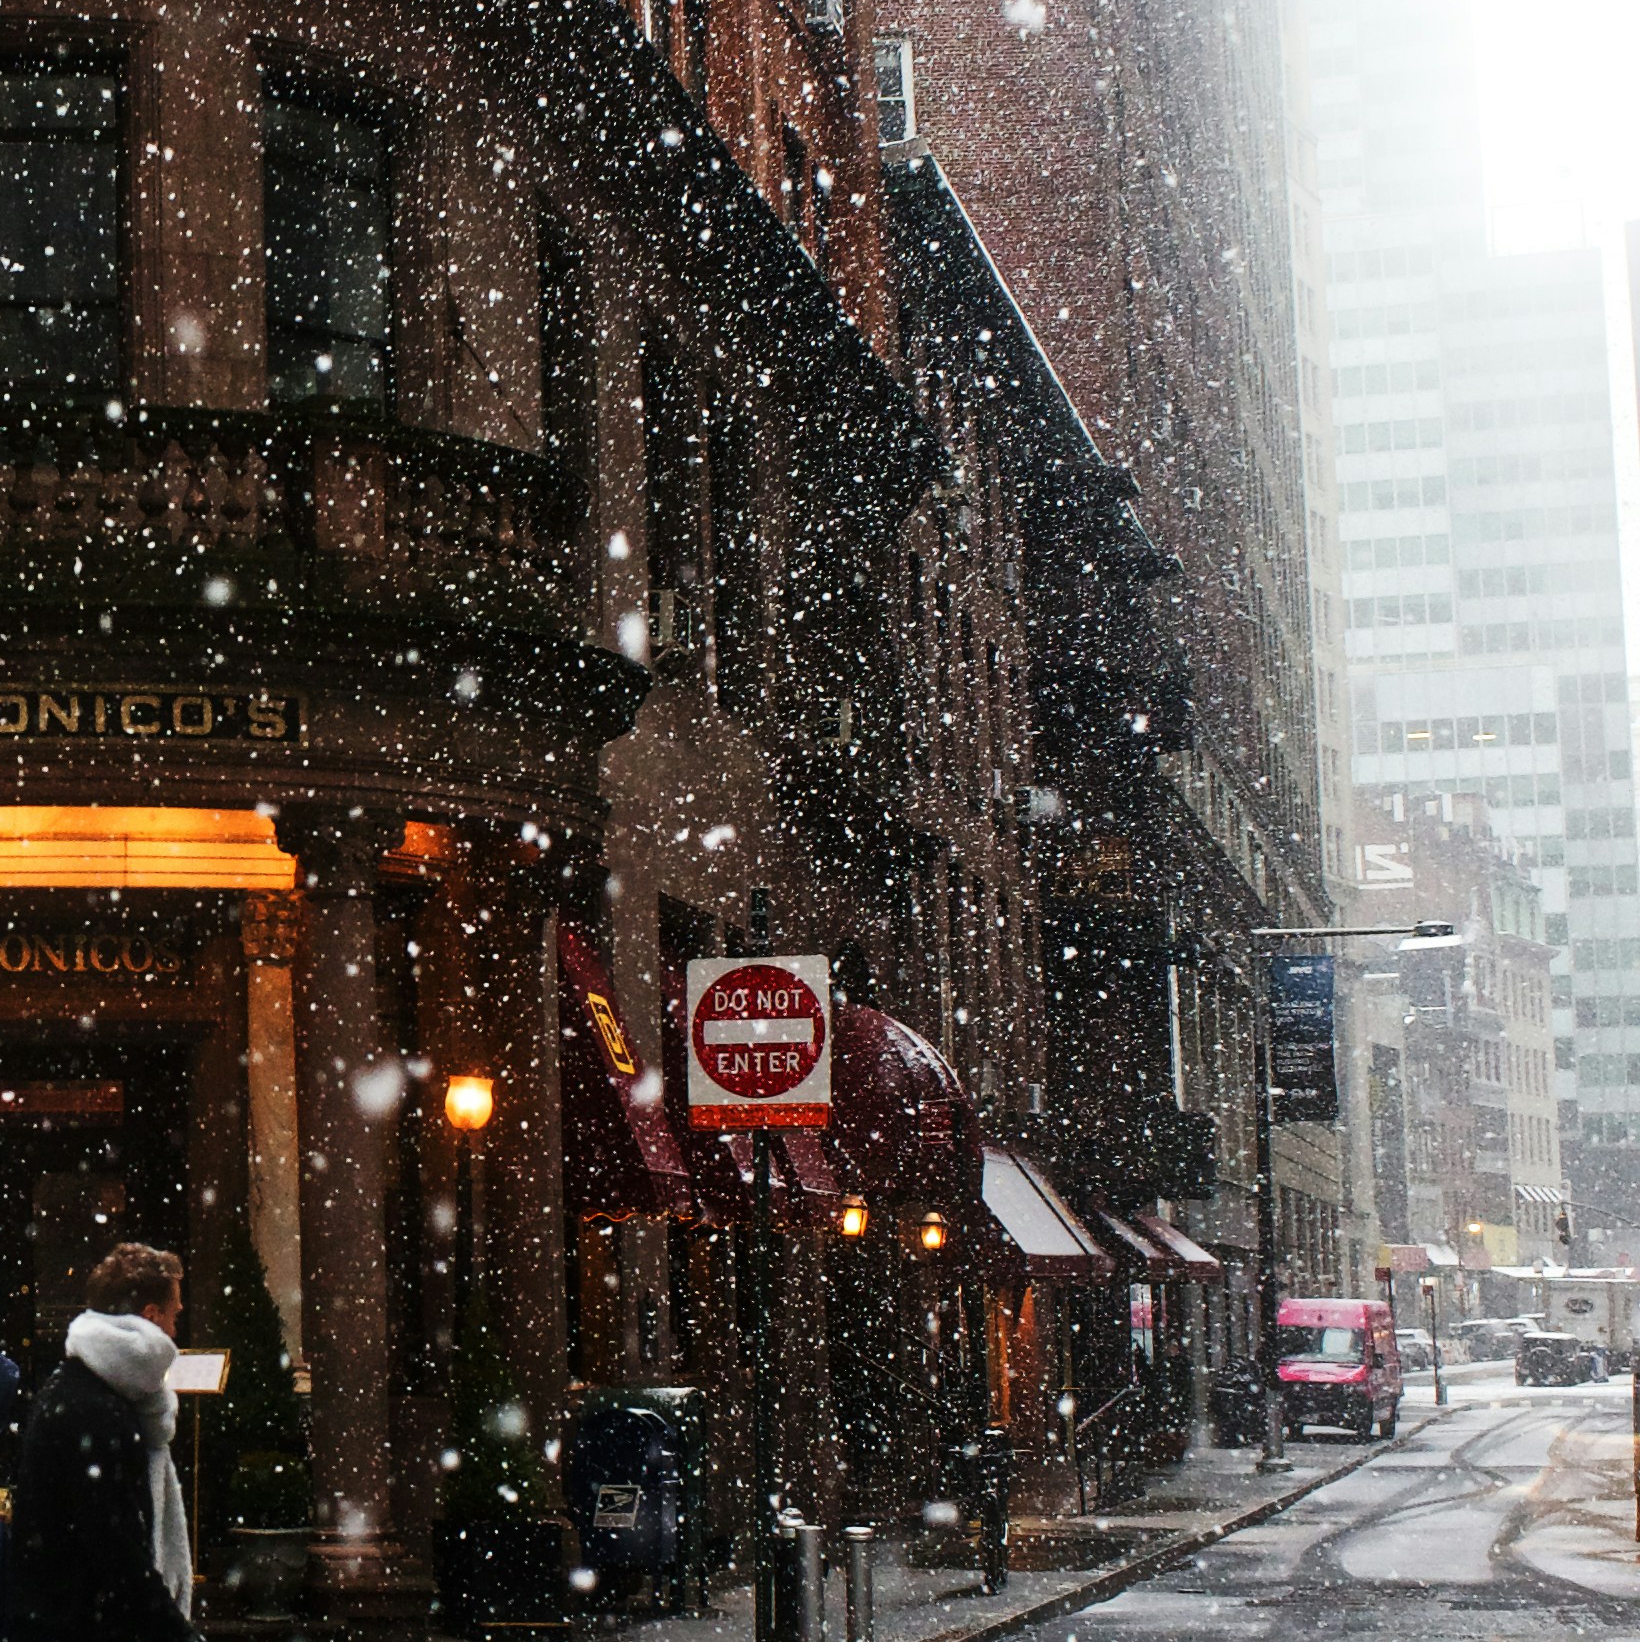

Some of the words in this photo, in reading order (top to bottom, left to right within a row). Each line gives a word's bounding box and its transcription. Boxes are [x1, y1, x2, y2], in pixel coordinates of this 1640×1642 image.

[714, 989, 747, 1012] DO
[757, 989, 804, 1011] NOT
[717, 1051, 800, 1074] ENTER
